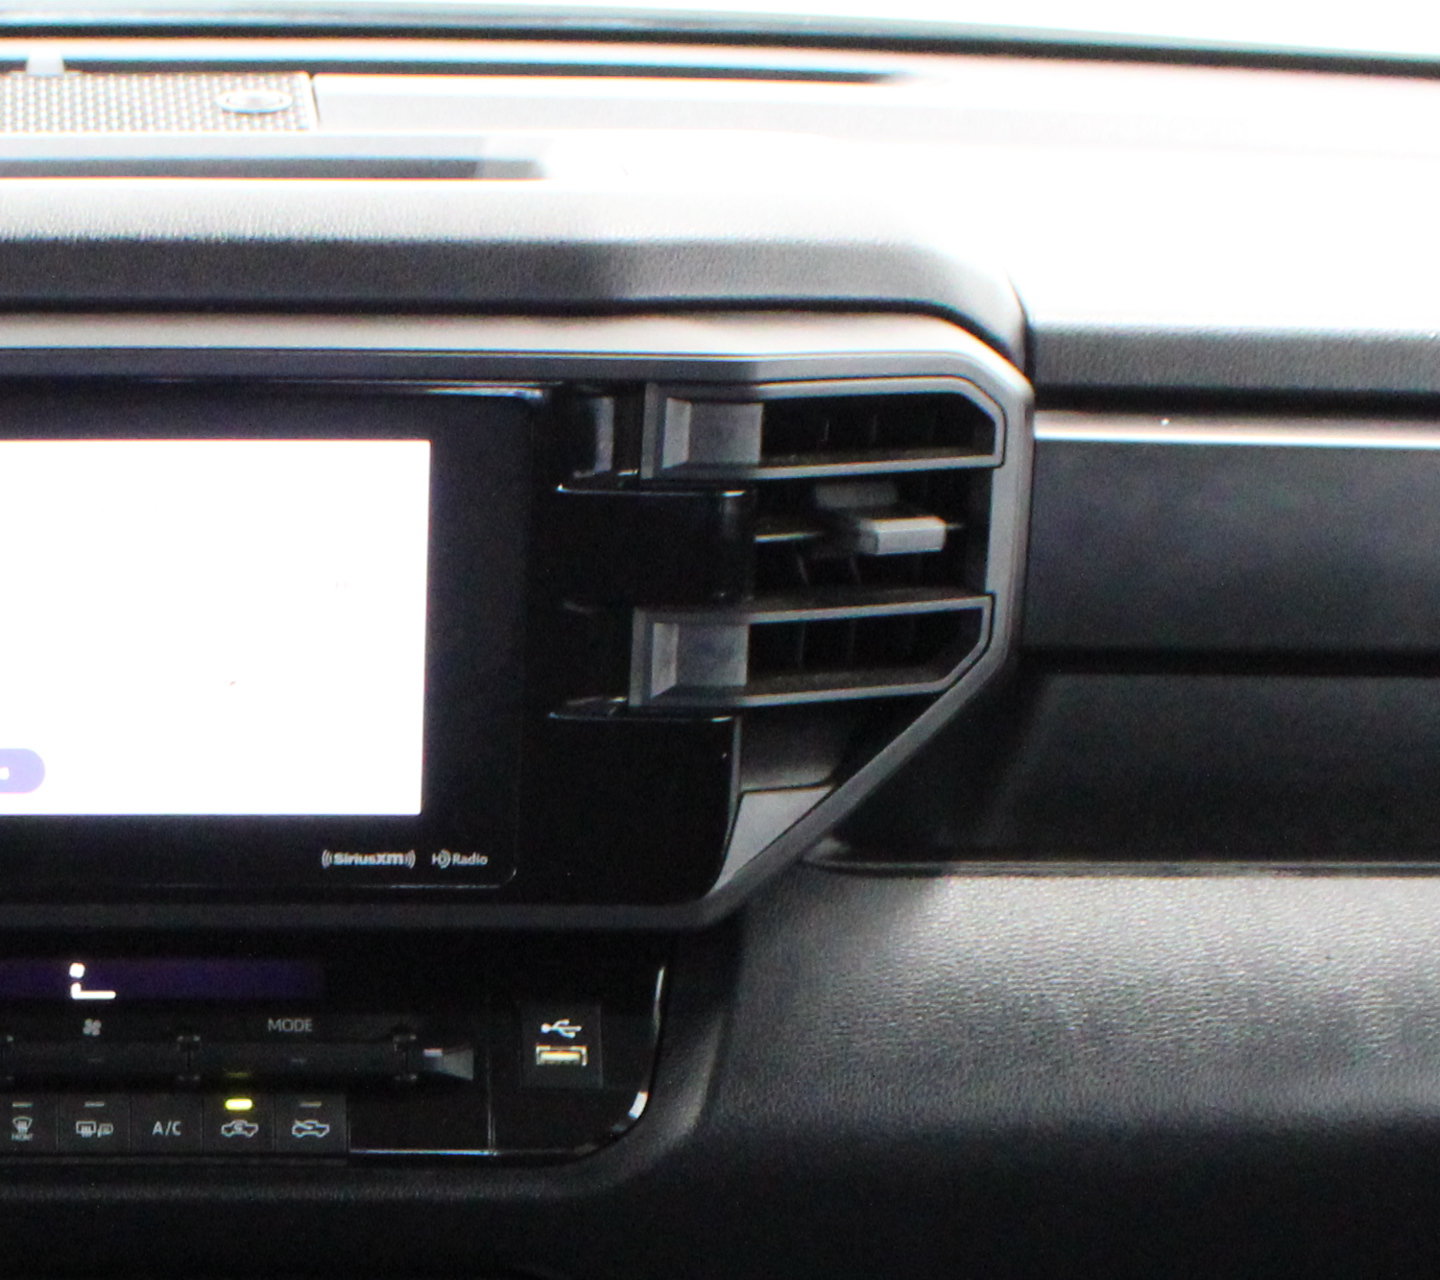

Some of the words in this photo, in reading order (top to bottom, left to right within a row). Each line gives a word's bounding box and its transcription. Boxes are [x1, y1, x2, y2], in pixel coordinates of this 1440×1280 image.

[452, 852, 489, 866] Radio
[267, 1017, 314, 1032] MODE
[152, 1120, 182, 1136] A/C
